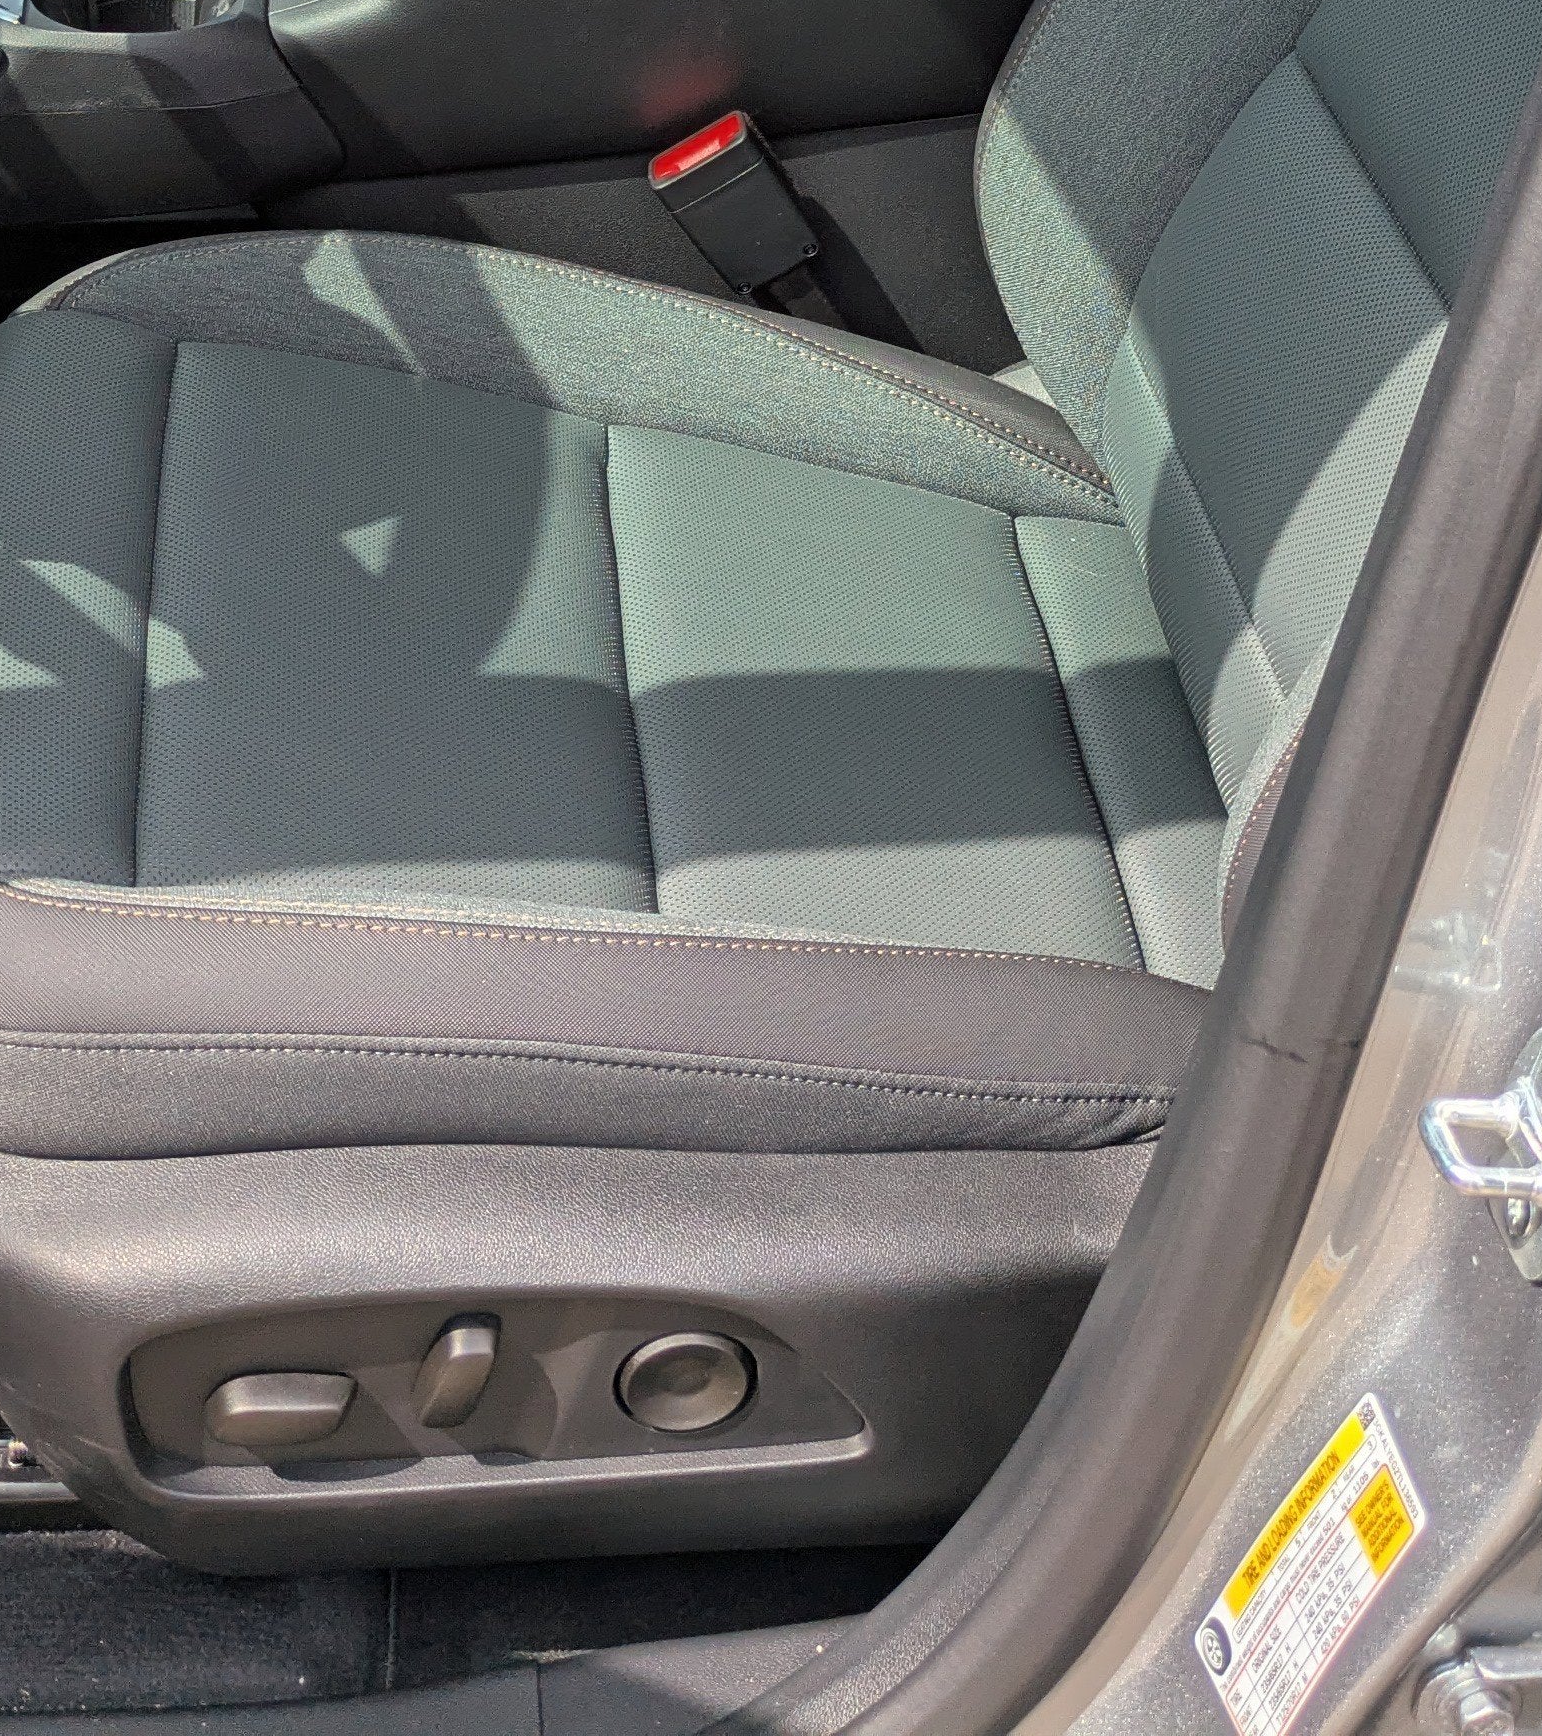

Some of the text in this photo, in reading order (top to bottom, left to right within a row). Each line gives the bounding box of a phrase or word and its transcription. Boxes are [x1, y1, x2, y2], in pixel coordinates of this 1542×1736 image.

[1366, 1439, 1373, 1452] 3
[1241, 1445, 1340, 1591] TIRE AND LOADING INFORMATION
[1322, 1515, 1335, 1536] 501
[1352, 1469, 1369, 1496] 1105
[1354, 1509, 1367, 1529] SEE
[1360, 1490, 1393, 1540] MANUAL FOR
[1367, 1505, 1397, 1549] ADDITIONAL
[1370, 1513, 1404, 1562] INFORMATION
[1295, 1530, 1345, 1605] COLD TIRE PRESSURE
[1333, 1560, 1345, 1580] PSI
[1341, 1577, 1353, 1597] PSI
[1251, 1623, 1281, 1674] ORIGINAL SIZE
